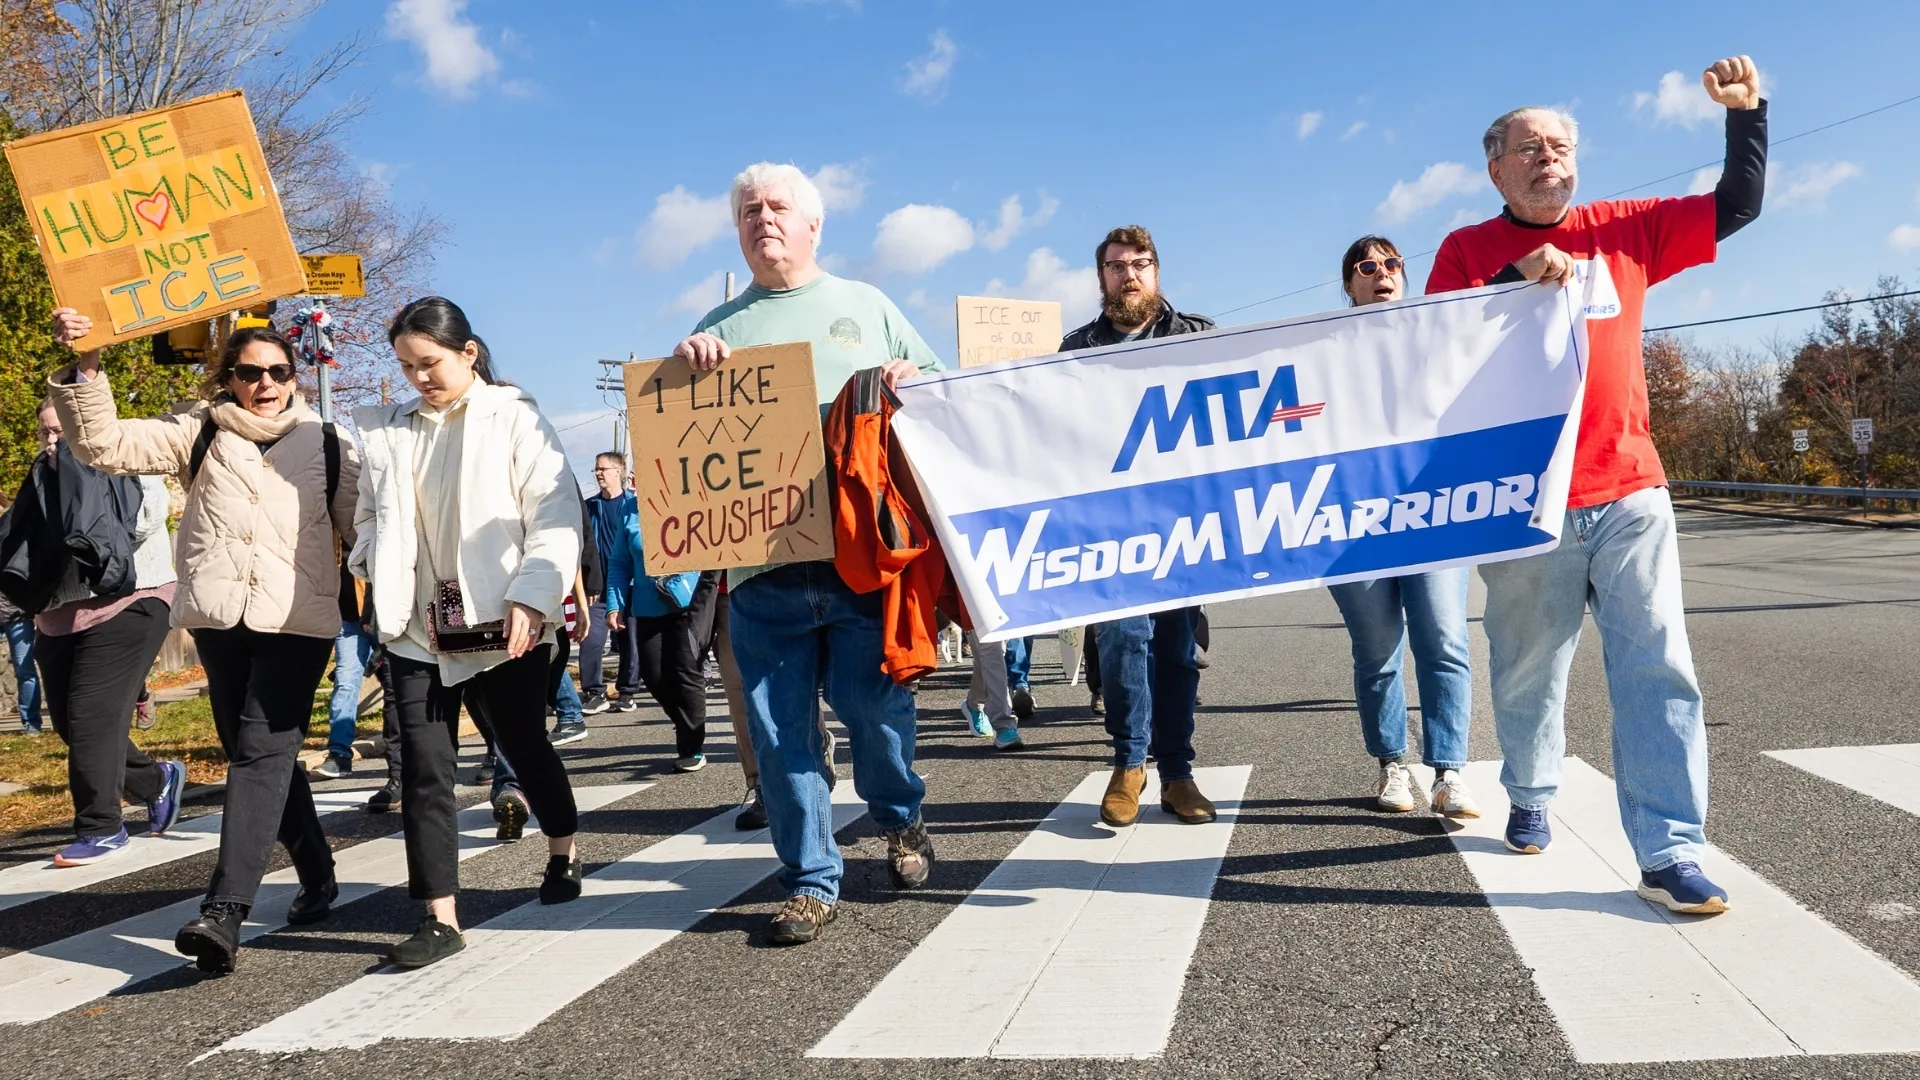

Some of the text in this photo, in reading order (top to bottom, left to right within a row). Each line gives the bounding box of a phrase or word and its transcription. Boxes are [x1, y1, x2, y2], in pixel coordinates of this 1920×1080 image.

[101, 120, 176, 170] BE
[43, 153, 254, 254] HUMAN
[144, 233, 210, 274] NOT
[110, 255, 260, 332] ICE
[974, 306, 1042, 326] ICE OUT
[1012, 331, 1034, 345] OUR
[654, 364, 778, 413] I LIKE
[677, 413, 765, 448] MY
[1111, 364, 1316, 474] MTA
[1854, 430, 1871, 440] 35
[1795, 440, 1807, 449] 20
[678, 448, 764, 495] ICE
[660, 478, 816, 558] CRUSHED!
[1234, 463, 1545, 556] WARRIOR
